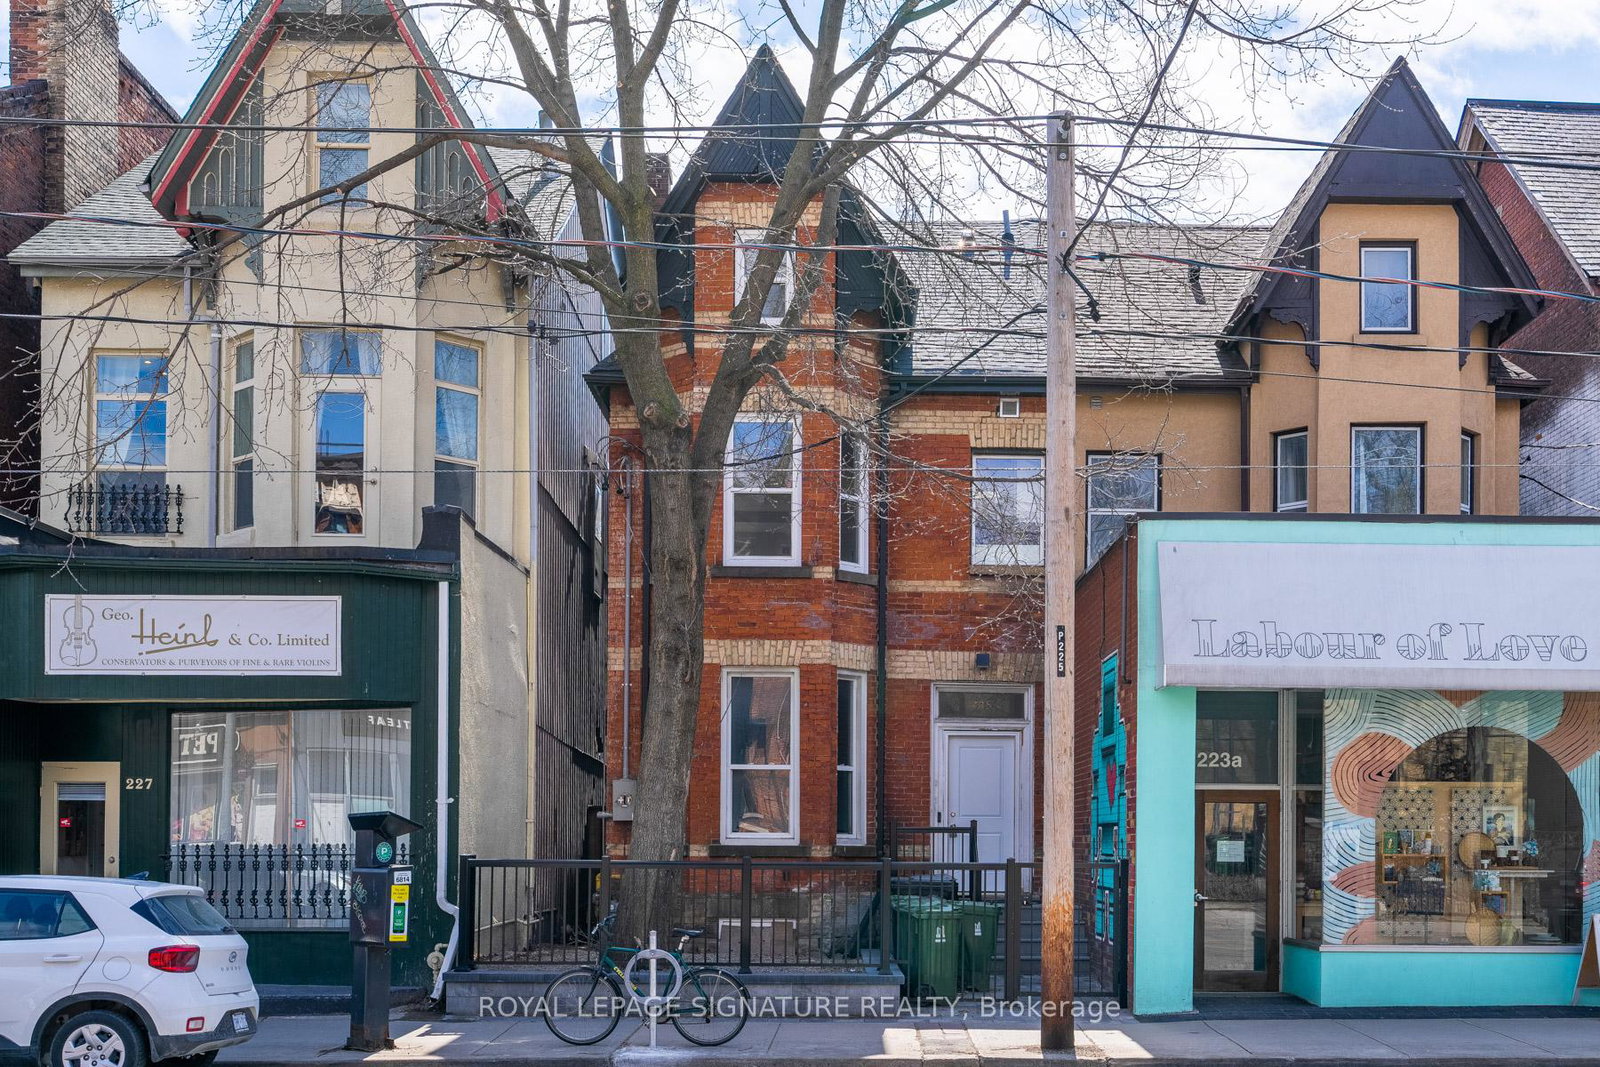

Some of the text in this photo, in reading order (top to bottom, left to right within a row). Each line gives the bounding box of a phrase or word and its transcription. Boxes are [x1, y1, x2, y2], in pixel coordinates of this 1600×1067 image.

[101, 607, 330, 650] Geo. Heinl & Co. Limited
[1191, 619, 1588, 662] Labour of Love
[101, 659, 331, 667] CONSERVATORS & PURVEYORS OF FINE & RARE VIOLINS
[1197, 751, 1242, 768] 223a
[125, 778, 153, 790] 227
[381, 847, 388, 855] P
